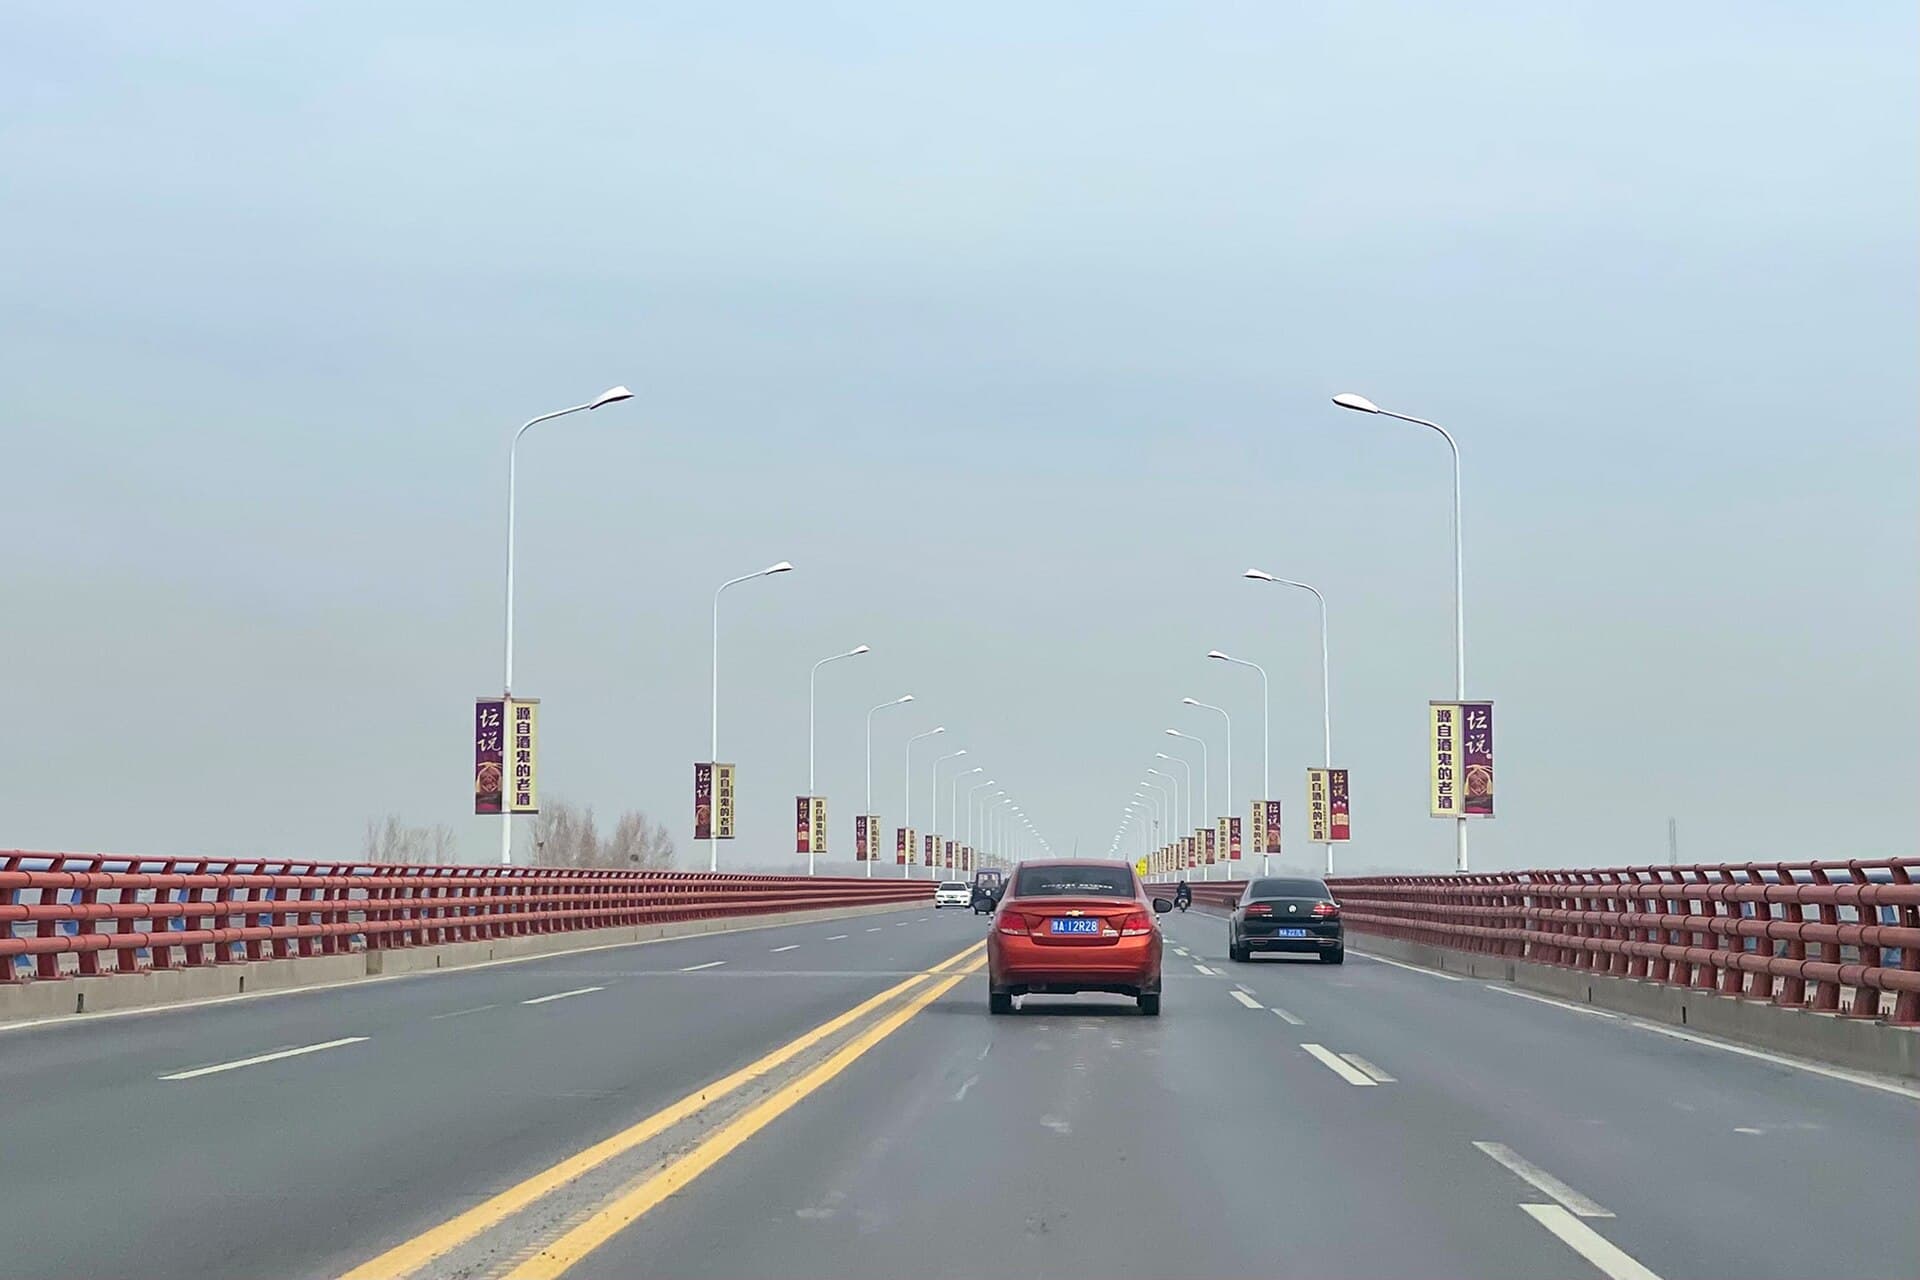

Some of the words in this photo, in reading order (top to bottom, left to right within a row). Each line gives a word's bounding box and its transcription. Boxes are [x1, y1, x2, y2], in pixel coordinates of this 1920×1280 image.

[477, 708, 501, 752] 坛说
[516, 707, 531, 805] 源自酒鬼的老酒
[1437, 709, 1452, 809] 源自酒鬼的老酒
[1465, 710, 1490, 754] 坛说
